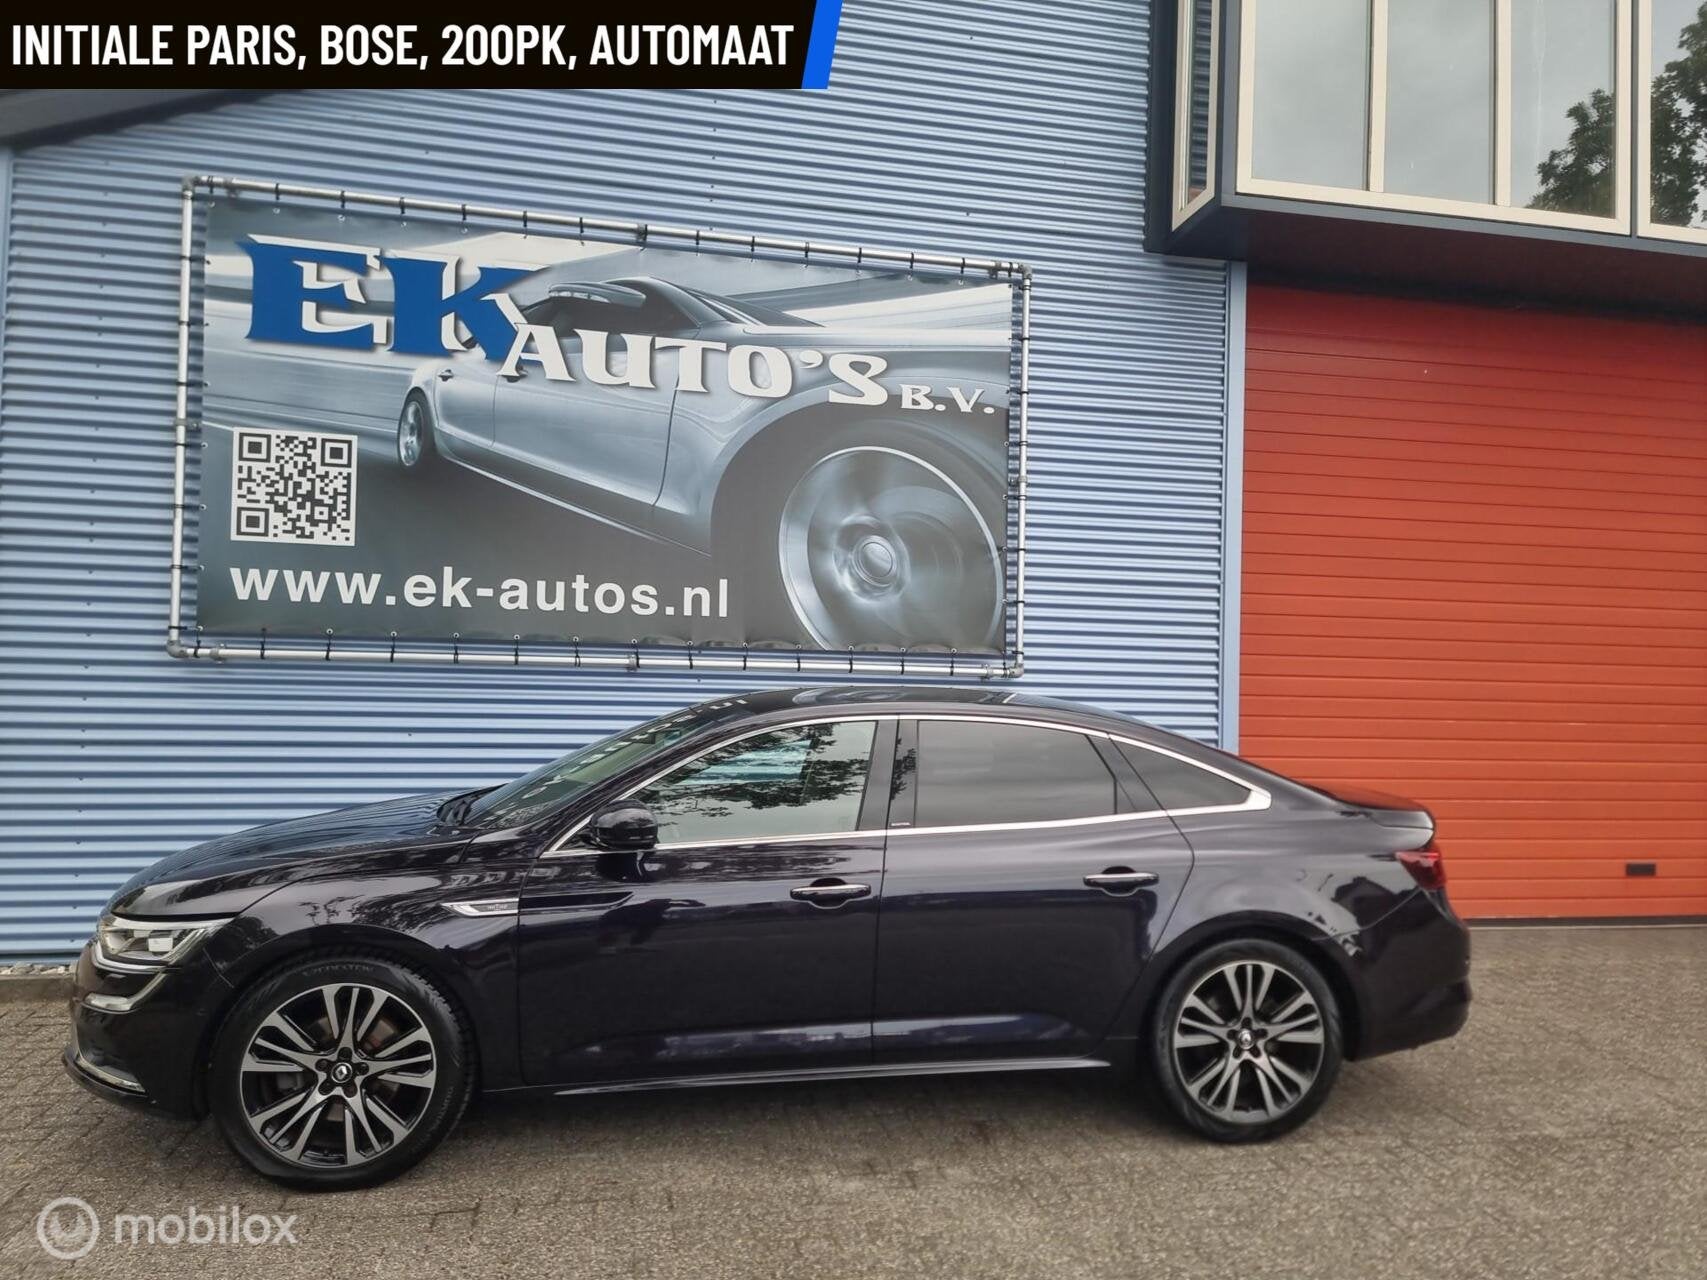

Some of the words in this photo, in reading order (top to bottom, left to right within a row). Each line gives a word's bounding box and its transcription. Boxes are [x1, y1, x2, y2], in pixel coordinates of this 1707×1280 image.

[235, 233, 551, 366] EK
[899, 383, 996, 415] B.V.
[229, 566, 729, 618] www.ek-autos.nl
